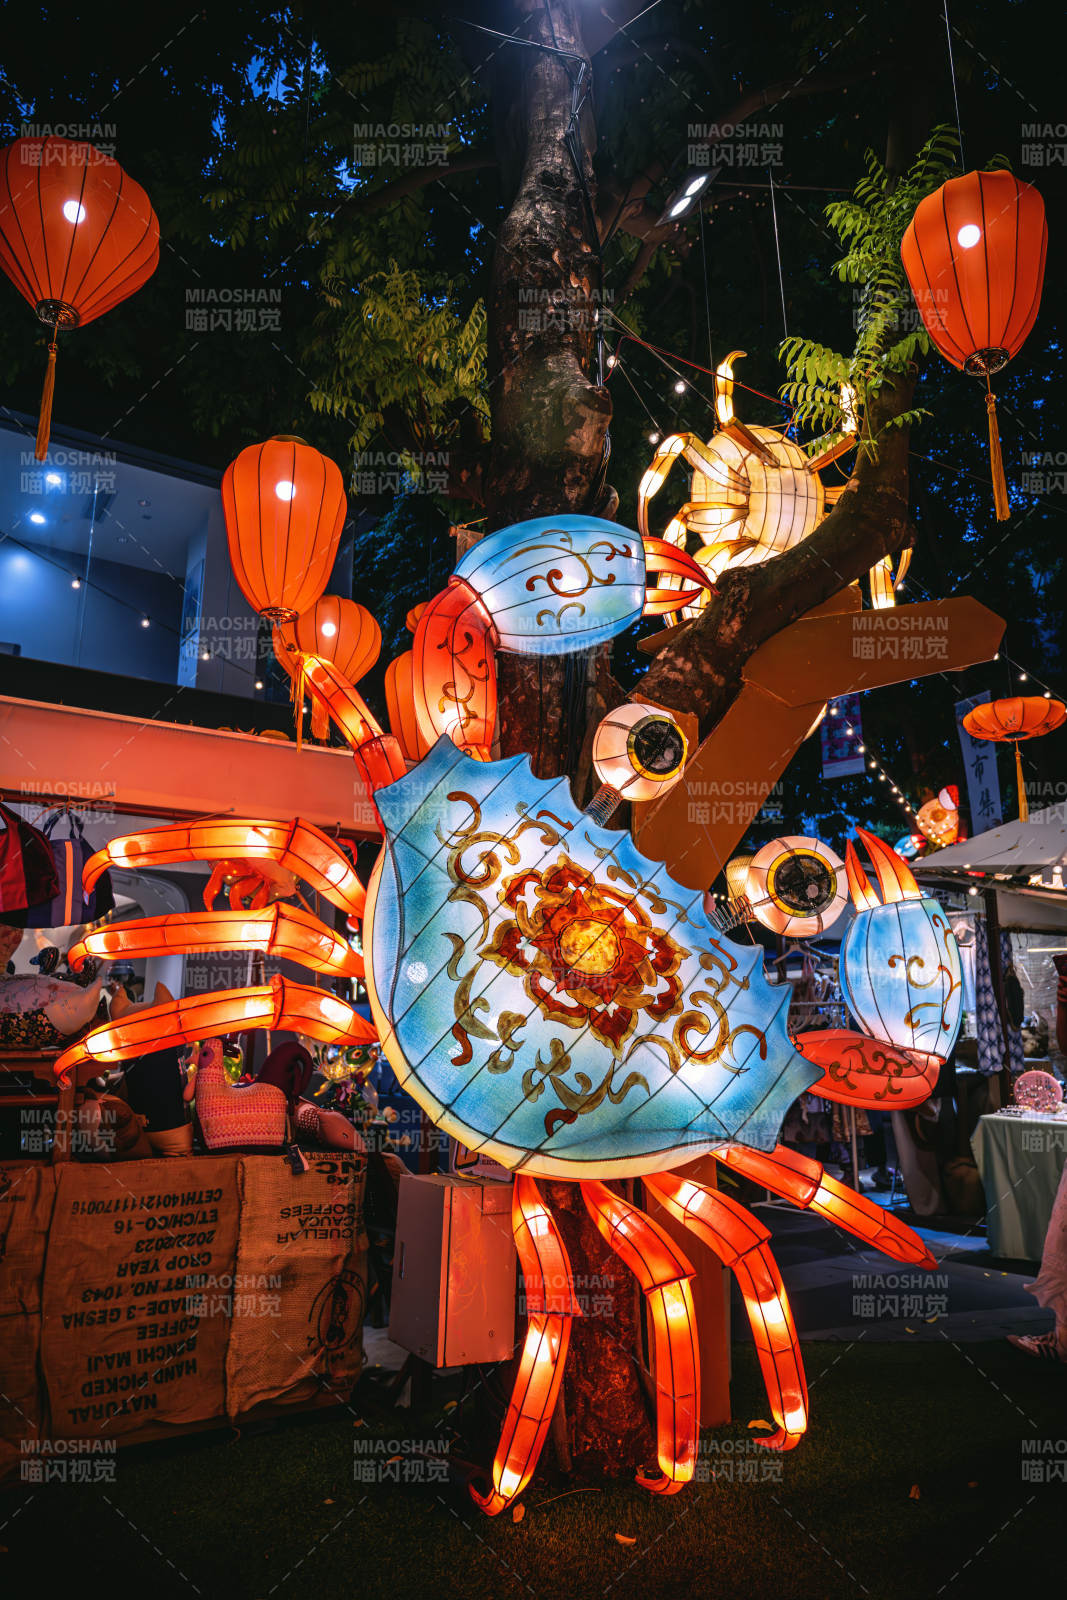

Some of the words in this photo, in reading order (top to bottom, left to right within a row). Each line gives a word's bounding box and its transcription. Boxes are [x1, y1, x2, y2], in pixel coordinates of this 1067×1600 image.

[298, 1216, 354, 1228] CAUCA
[134, 1230, 216, 1253] 2022/2023
[277, 1228, 353, 1244] CUELLAR
[116, 1259, 160, 1277] YEAR
[166, 1252, 212, 1270] CROP
[130, 1281, 158, 1297] NO.
[62, 1309, 121, 1329] GESHA
[136, 1315, 200, 1340] COFFEE
[87, 1351, 131, 1372] MAJI
[153, 1358, 197, 1385] HAND
[81, 1371, 148, 1397] PICKED
[67, 1393, 157, 1424] NATURAL
